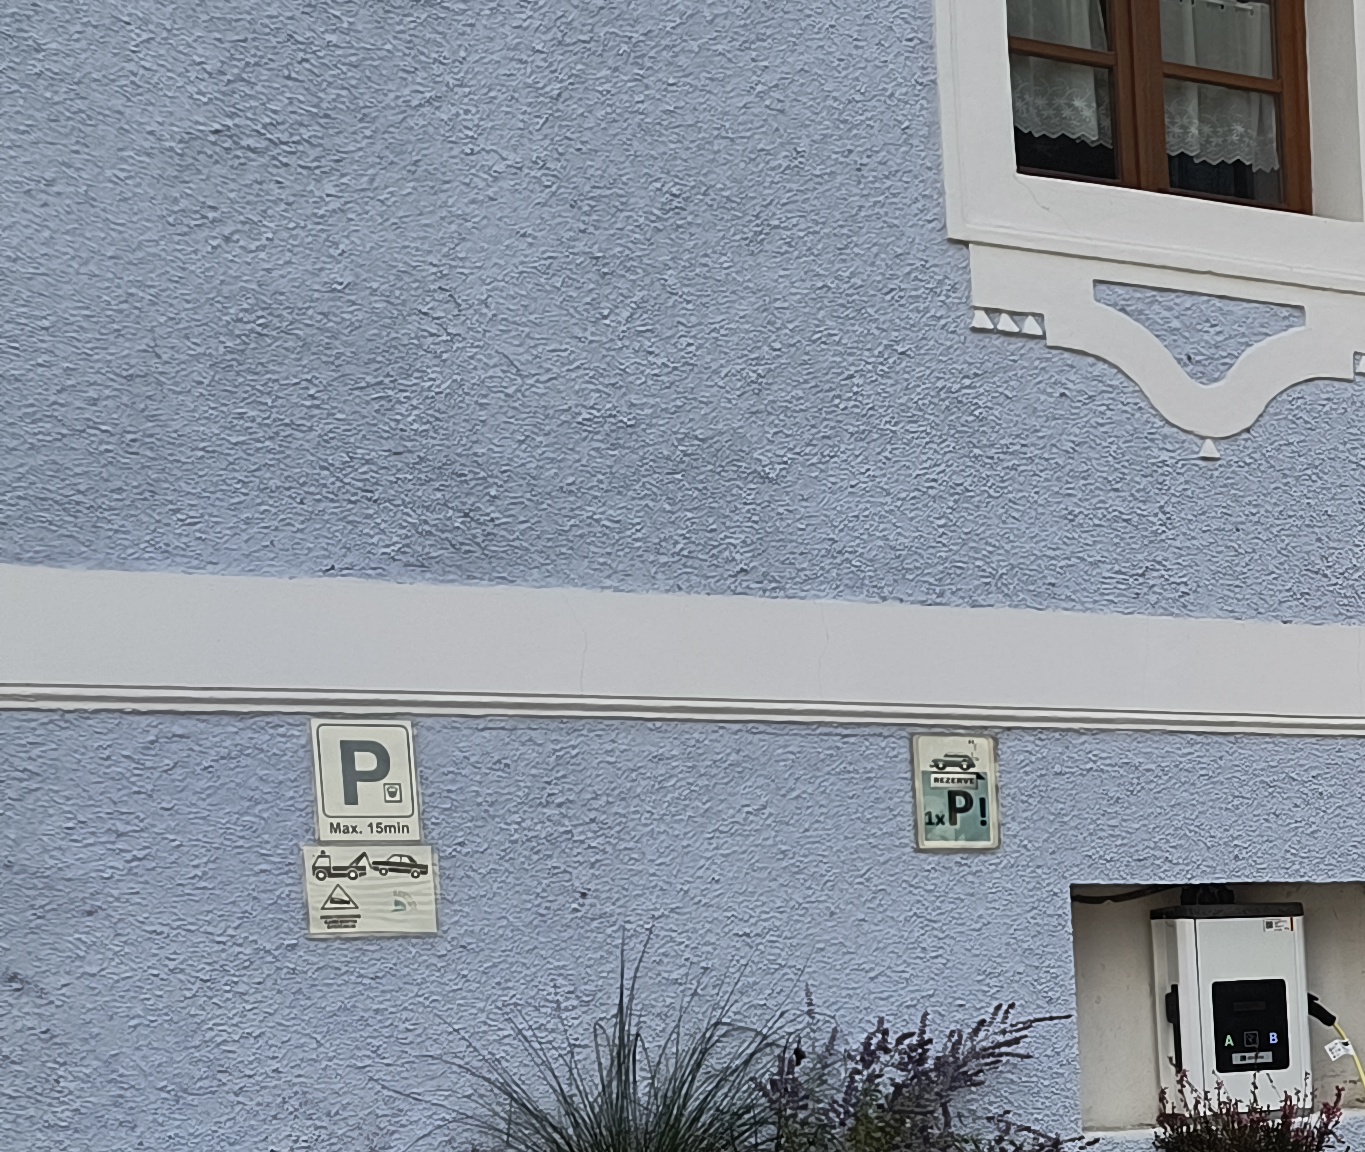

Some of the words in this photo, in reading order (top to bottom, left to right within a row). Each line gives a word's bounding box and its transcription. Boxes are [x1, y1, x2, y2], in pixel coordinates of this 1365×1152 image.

[340, 740, 391, 805] P
[329, 821, 363, 834] Max.
[367, 821, 410, 834] 15min
